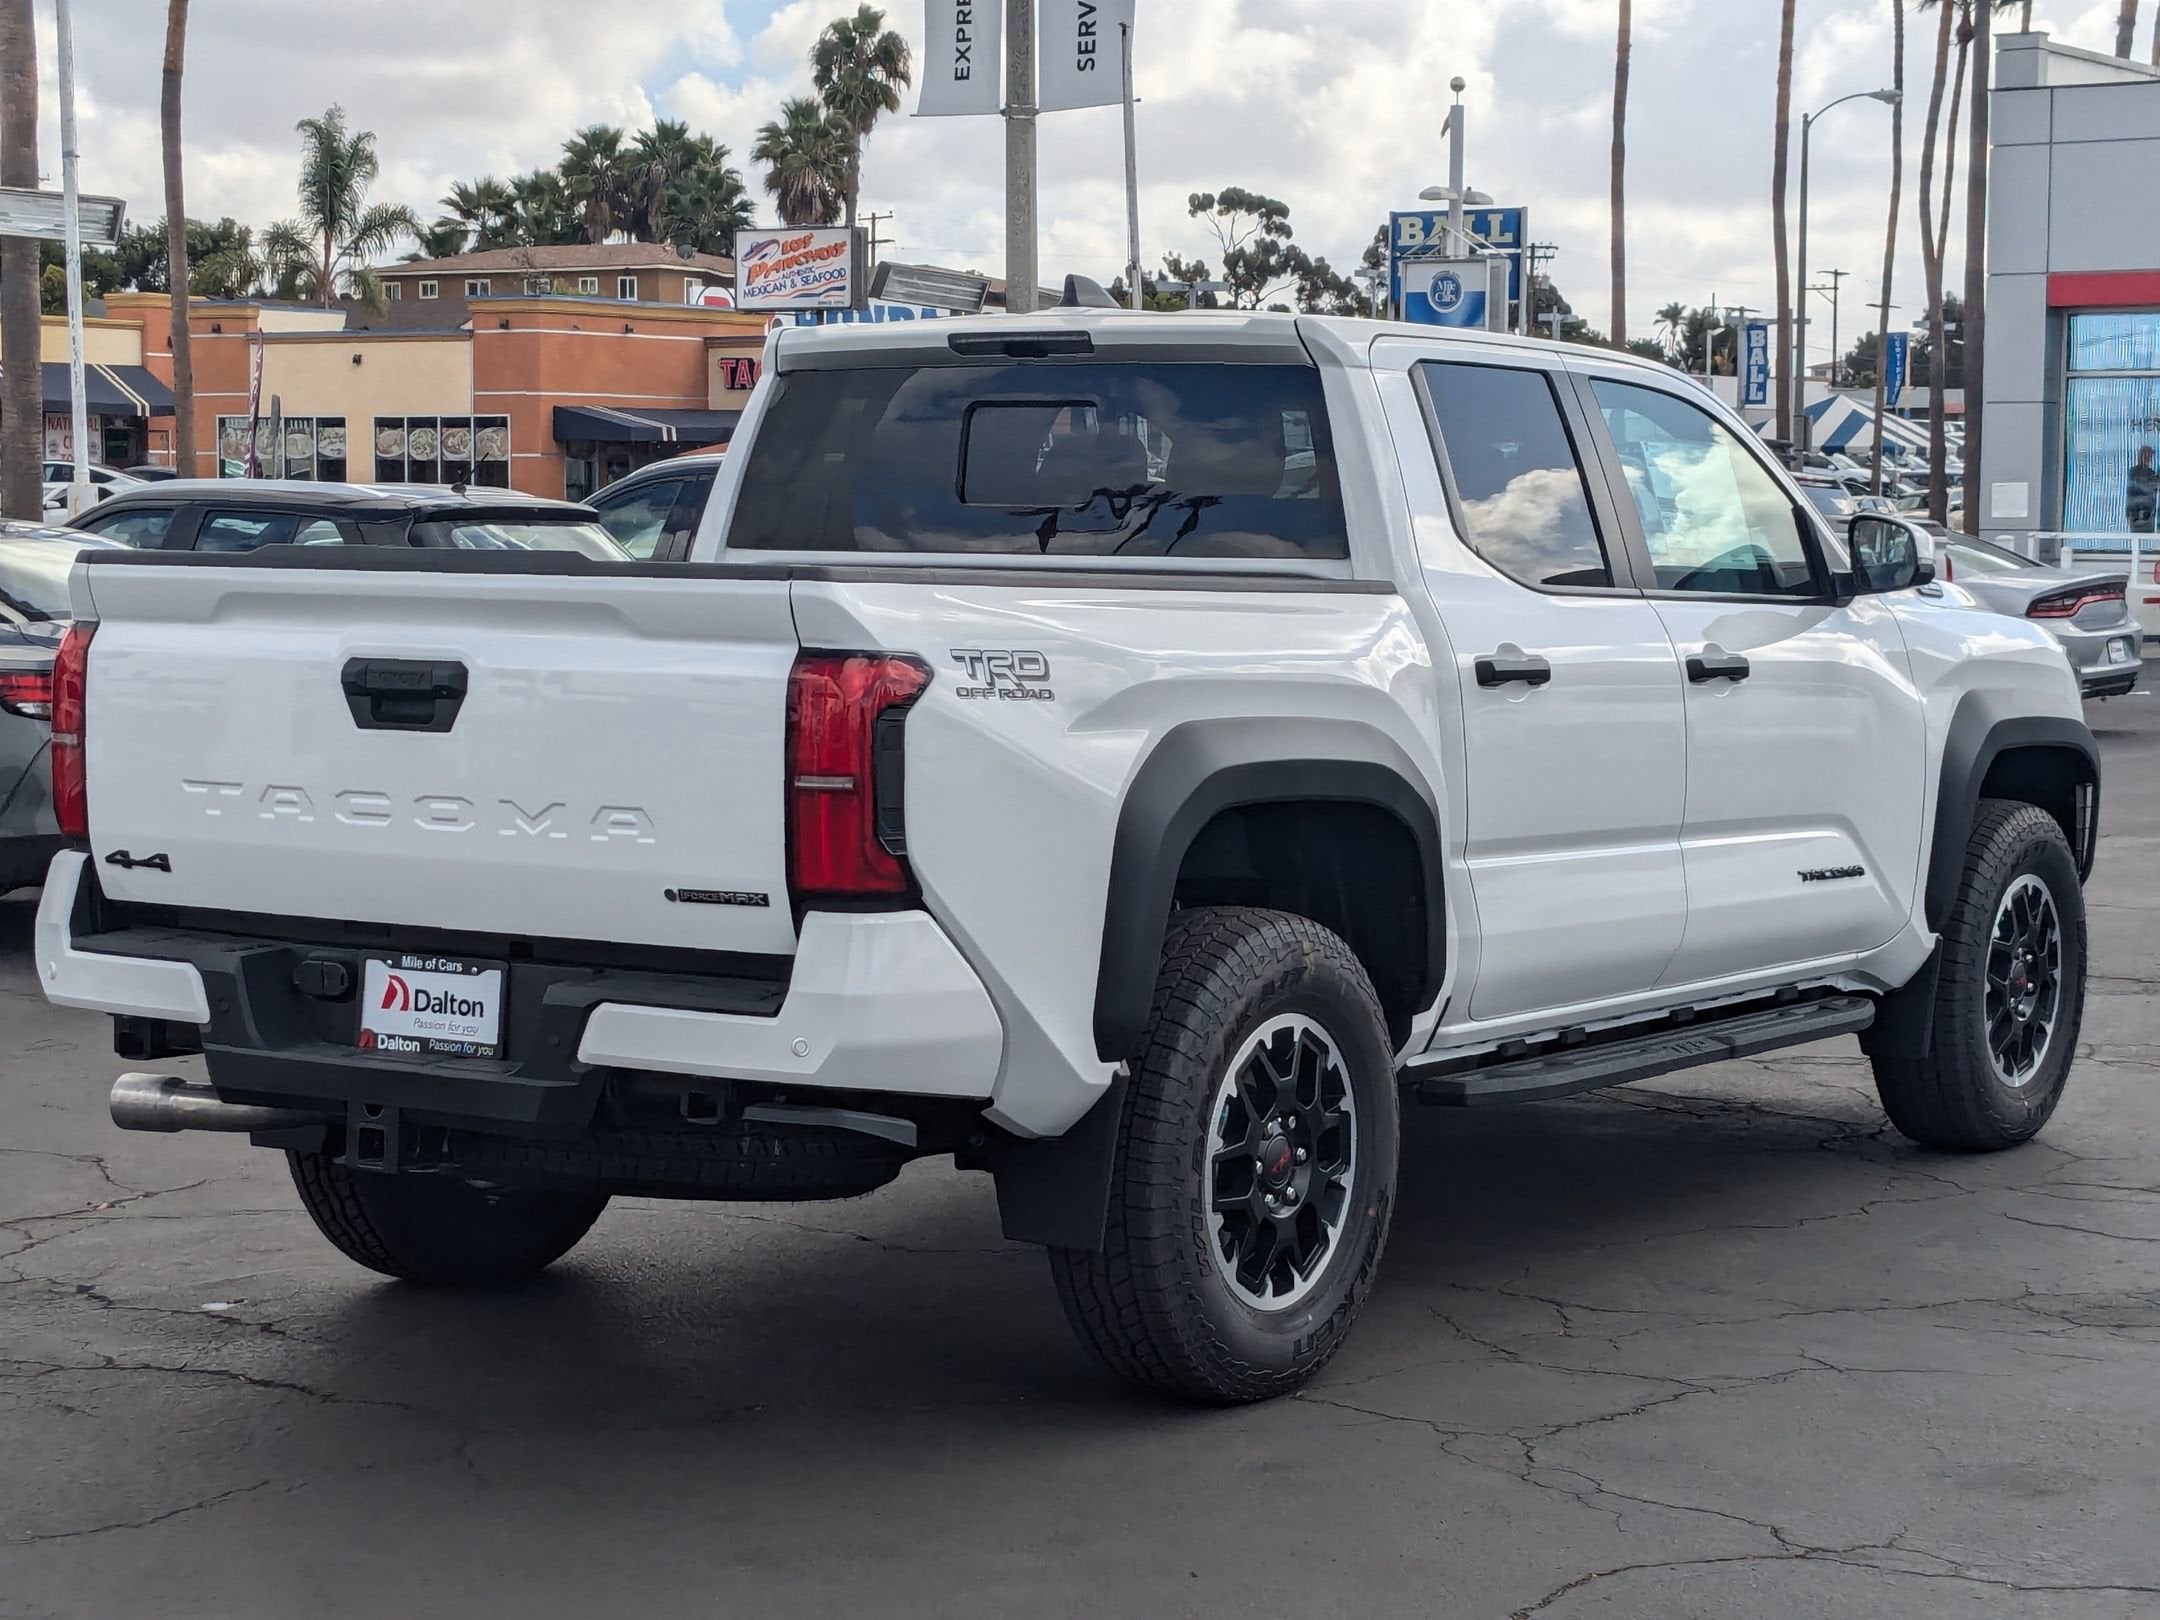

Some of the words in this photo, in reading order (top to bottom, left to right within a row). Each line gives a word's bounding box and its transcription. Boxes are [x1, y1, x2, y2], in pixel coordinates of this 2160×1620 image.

[1077, 0, 1097, 72] SERV
[743, 280, 787, 299] MEXICAN
[790, 279, 798, 289] &
[800, 267, 847, 287] SEAFOOD
[1748, 329, 1766, 401] BALL
[47, 416, 99, 431] NATIAL
[949, 649, 1050, 688] TRD
[956, 687, 996, 700] OFF
[998, 688, 1055, 702] ROAD
[181, 778, 656, 845] TACOMA
[401, 955, 423, 969] Mile
[425, 958, 436, 970] of
[438, 959, 464, 972] Cars
[414, 988, 484, 1018] Dalton
[413, 1017, 447, 1031] Passion
[448, 1020, 461, 1033] for
[462, 1025, 480, 1036] you
[377, 1034, 421, 1053] Dalton
[428, 1038, 462, 1053] Passion
[463, 1042, 476, 1054] for
[477, 1046, 494, 1057] you
